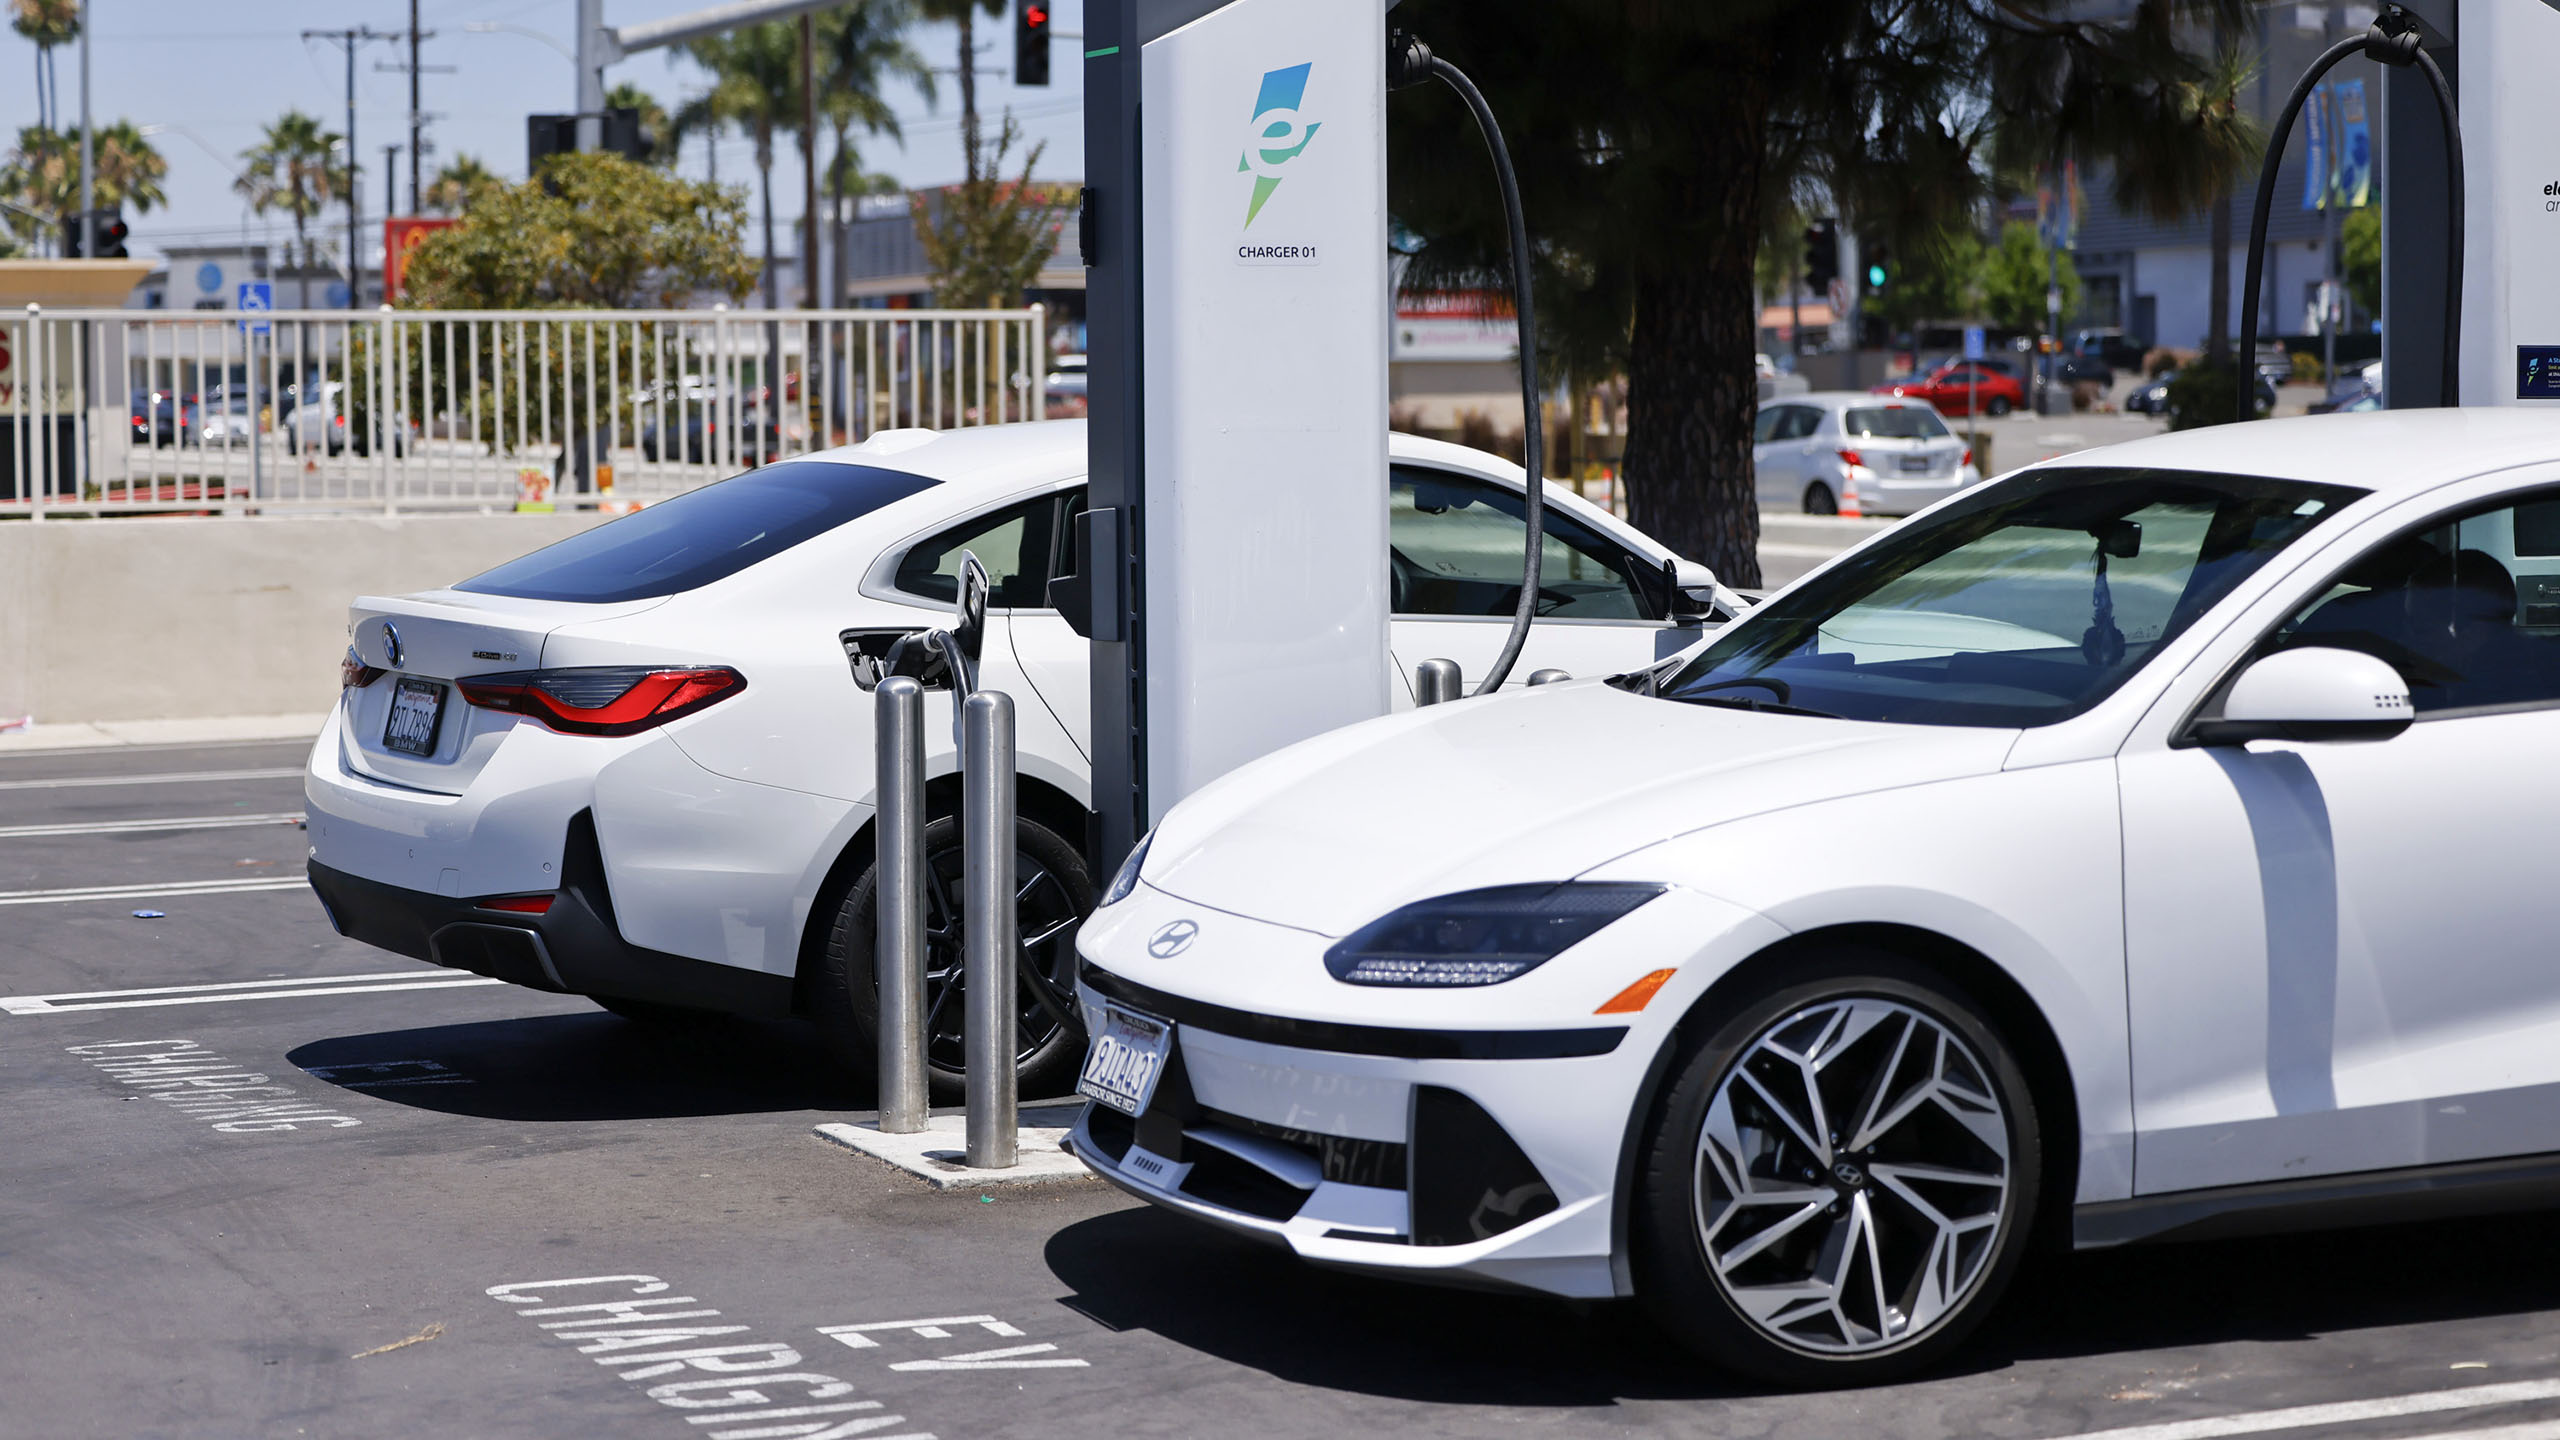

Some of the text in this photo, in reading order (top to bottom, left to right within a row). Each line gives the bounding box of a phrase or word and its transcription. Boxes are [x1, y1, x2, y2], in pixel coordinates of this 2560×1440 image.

[2544, 180, 2560, 196] el
[1238, 246, 1316, 258] CHARGER 01
[393, 738, 417, 750] BMW
[64, 1039, 364, 1133] CHARGING
[298, 1060, 478, 1089] EV
[1080, 1081, 1106, 1101] HARBOR
[1104, 1090, 1123, 1108] SINCE
[816, 1314, 1091, 1372] EV
